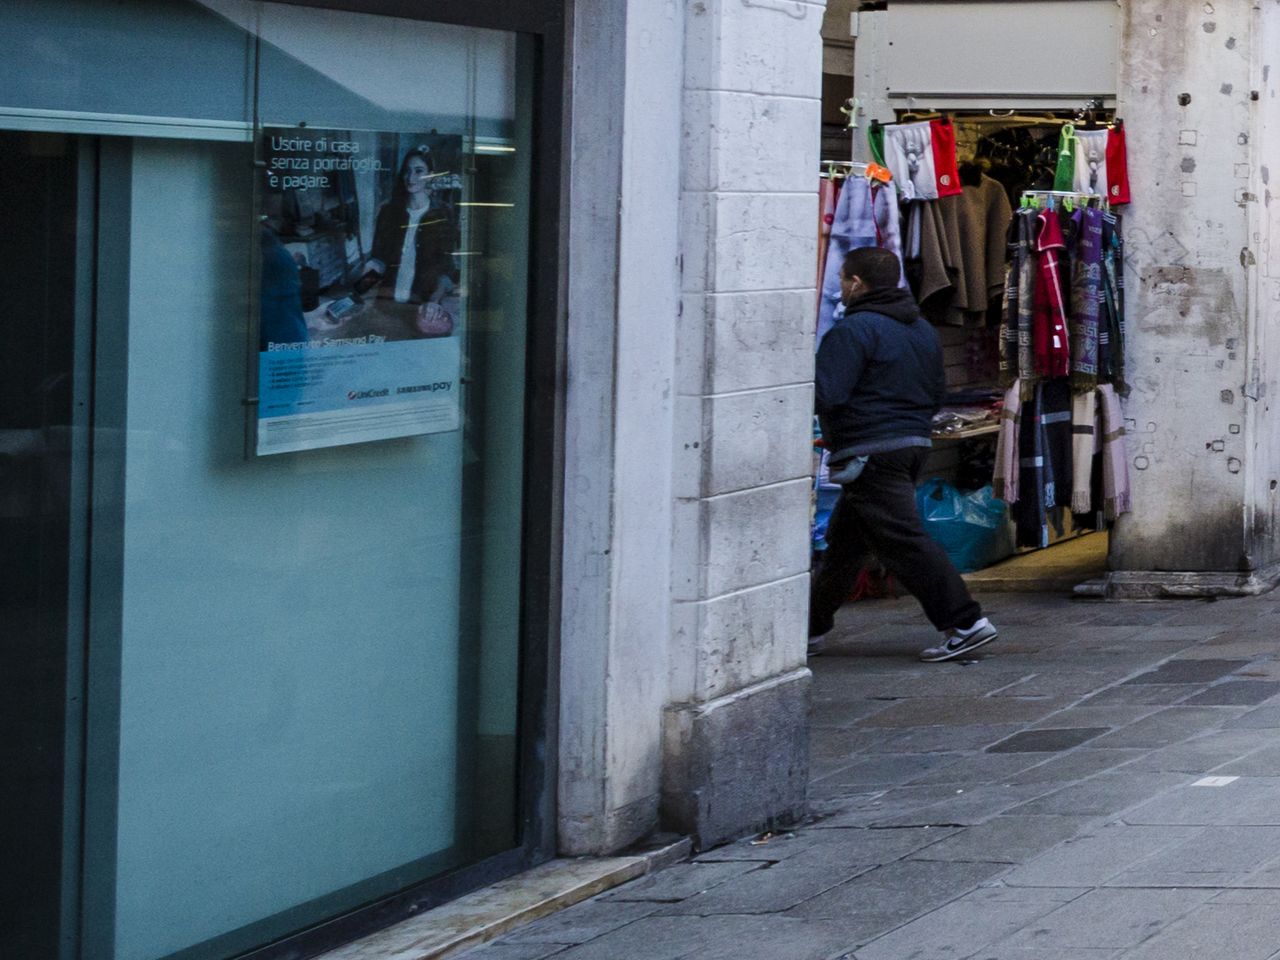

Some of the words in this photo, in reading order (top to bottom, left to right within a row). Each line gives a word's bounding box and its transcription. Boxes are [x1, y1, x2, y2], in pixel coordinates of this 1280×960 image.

[271, 136, 312, 152] Uscire
[315, 138, 327, 152] di
[331, 141, 360, 153] casa
[271, 158, 309, 170] senza
[270, 175, 278, 188] e
[432, 381, 453, 393] pay
